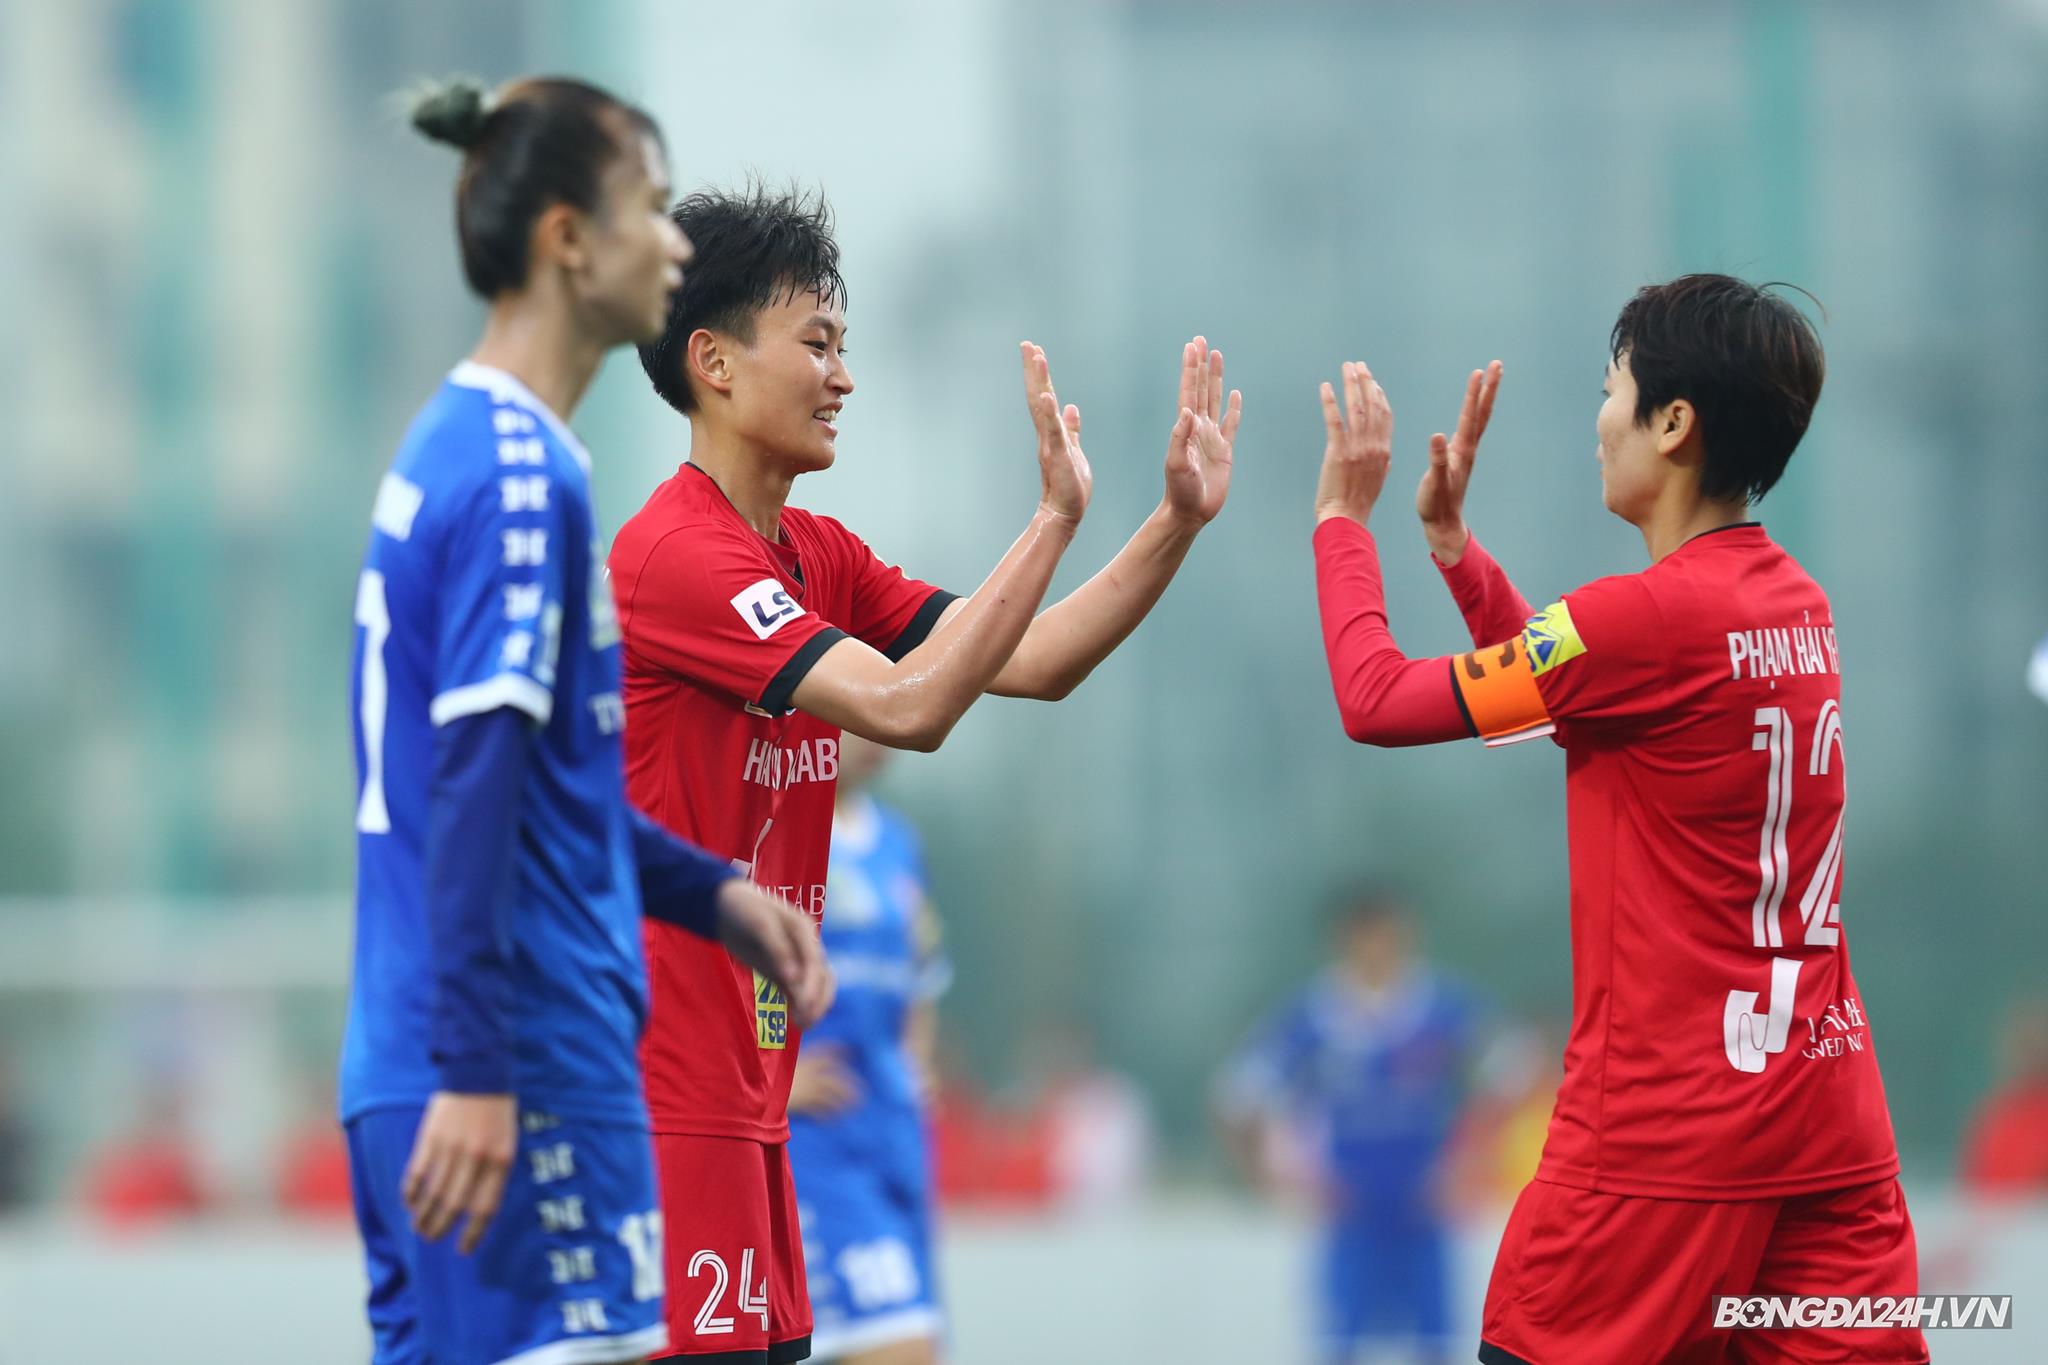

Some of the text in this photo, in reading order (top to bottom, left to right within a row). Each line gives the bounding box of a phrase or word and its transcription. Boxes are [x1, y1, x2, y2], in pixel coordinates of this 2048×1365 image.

[1727, 628, 1796, 690] PHẠM
[1752, 699, 1847, 947] 12
[758, 1009, 786, 1043] TSB
[687, 1248, 769, 1335] 24
